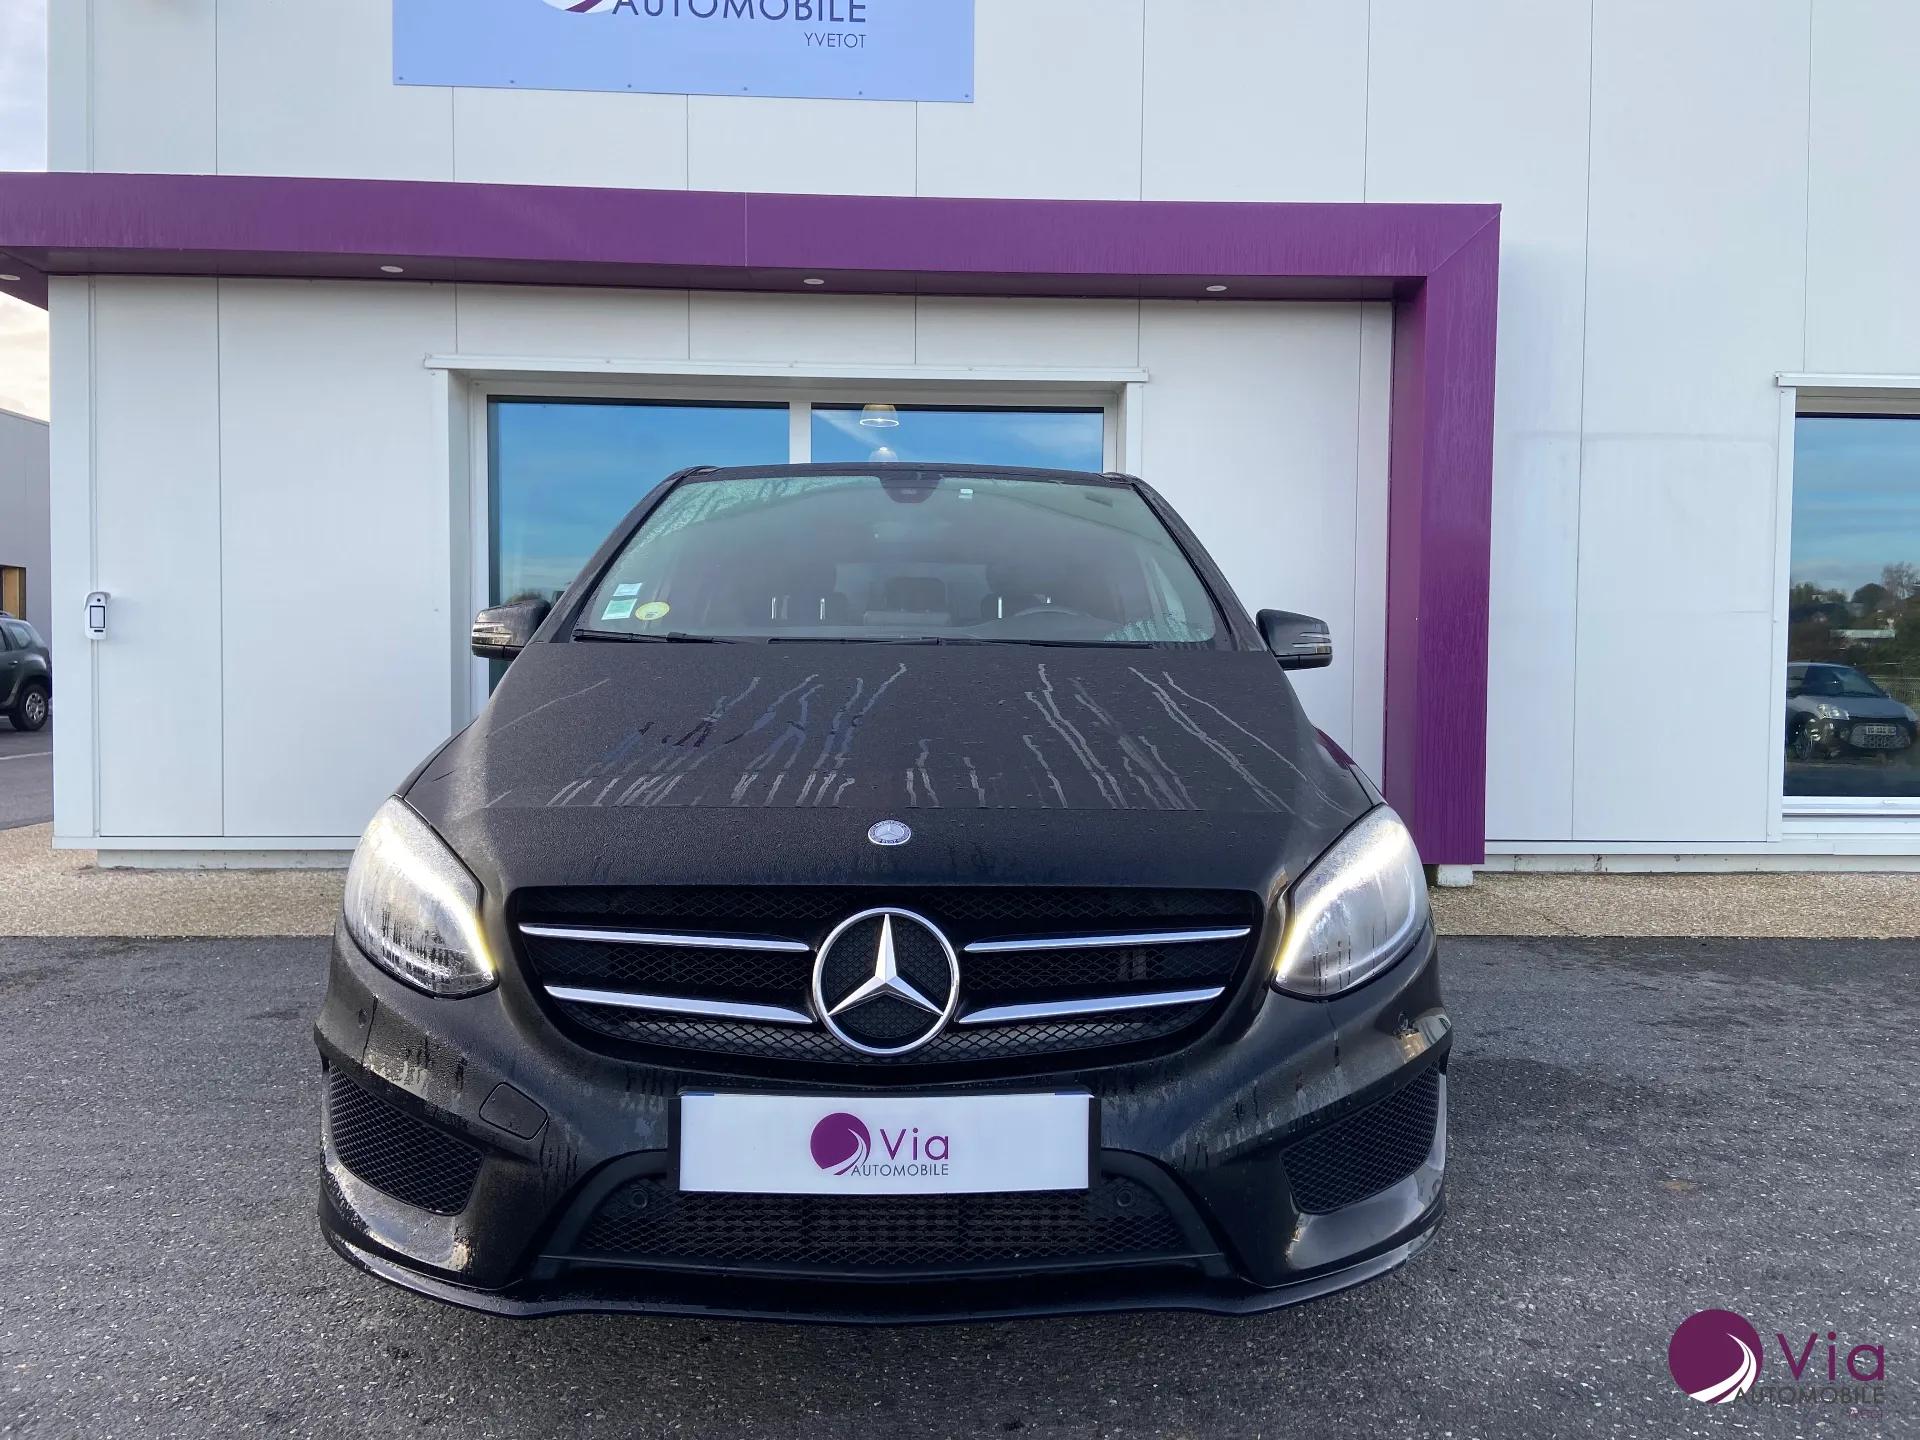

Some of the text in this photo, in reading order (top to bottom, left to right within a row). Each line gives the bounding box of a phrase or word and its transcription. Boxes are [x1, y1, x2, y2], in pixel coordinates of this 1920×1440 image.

[612, 0, 866, 23] AUTOMOBILE
[804, 32, 867, 49] YVETOT
[879, 1127, 949, 1161] Via
[850, 1163, 949, 1177] AUTOMOBILE
